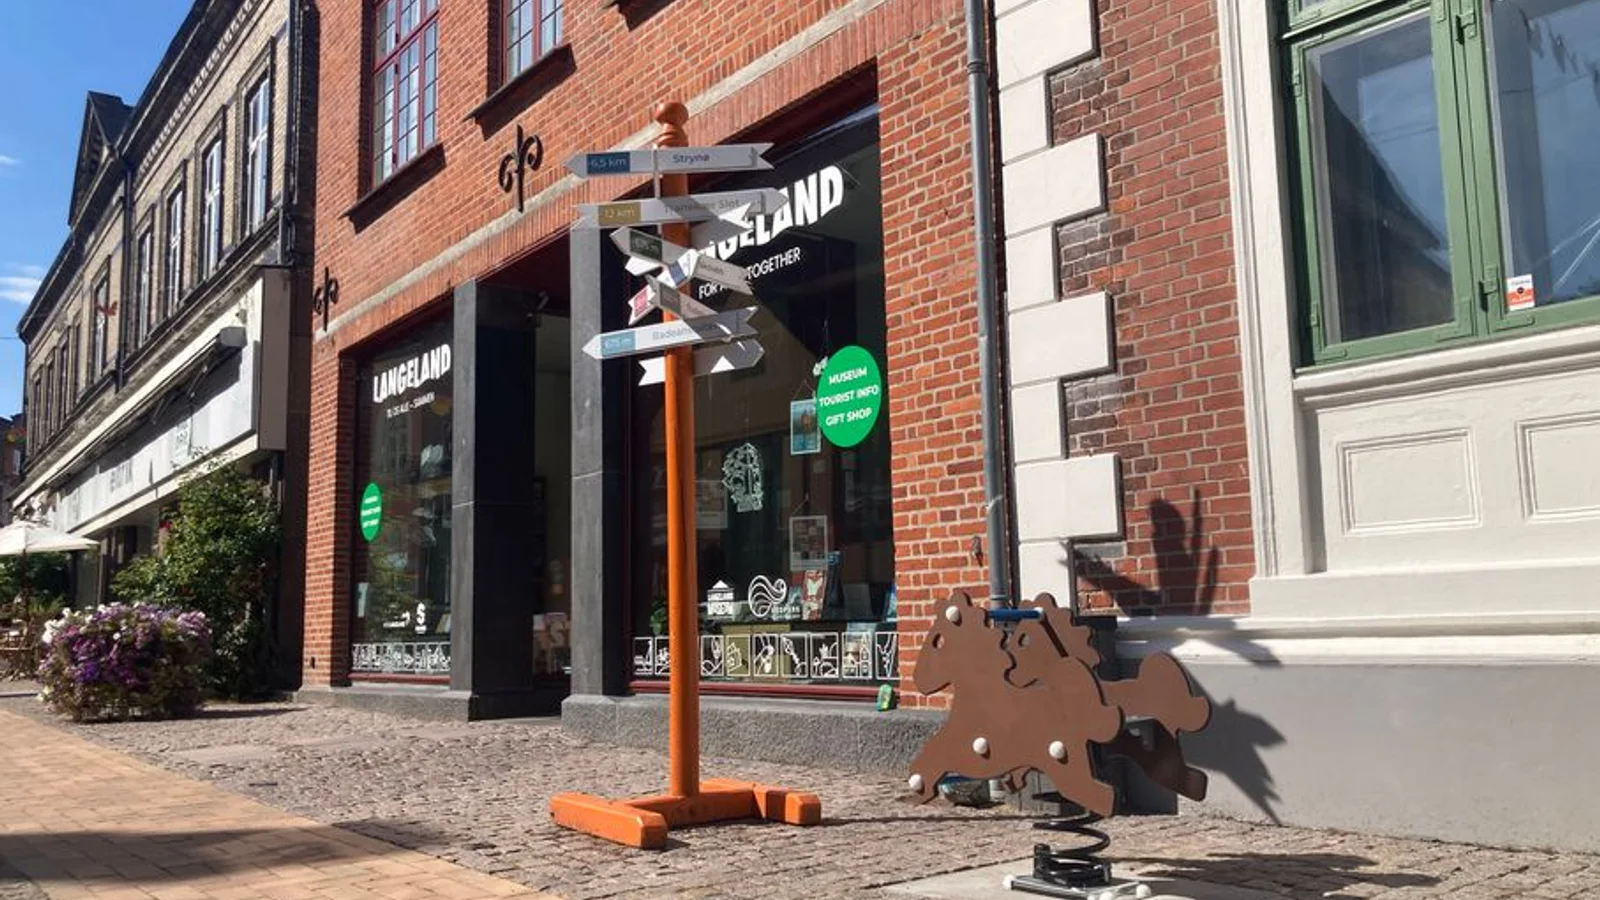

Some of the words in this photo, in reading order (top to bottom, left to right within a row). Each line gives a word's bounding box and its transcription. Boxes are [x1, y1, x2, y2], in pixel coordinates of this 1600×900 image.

[608, 156, 627, 167] km
[617, 206, 635, 217] km
[747, 246, 801, 280] TOGETHER
[373, 344, 451, 403] LANGELAND
[828, 366, 868, 385] MUSEUM
[819, 390, 855, 407] TOURIST
[856, 385, 880, 399] INFO
[825, 413, 845, 427] GIFT
[846, 407, 873, 422] SHOP
